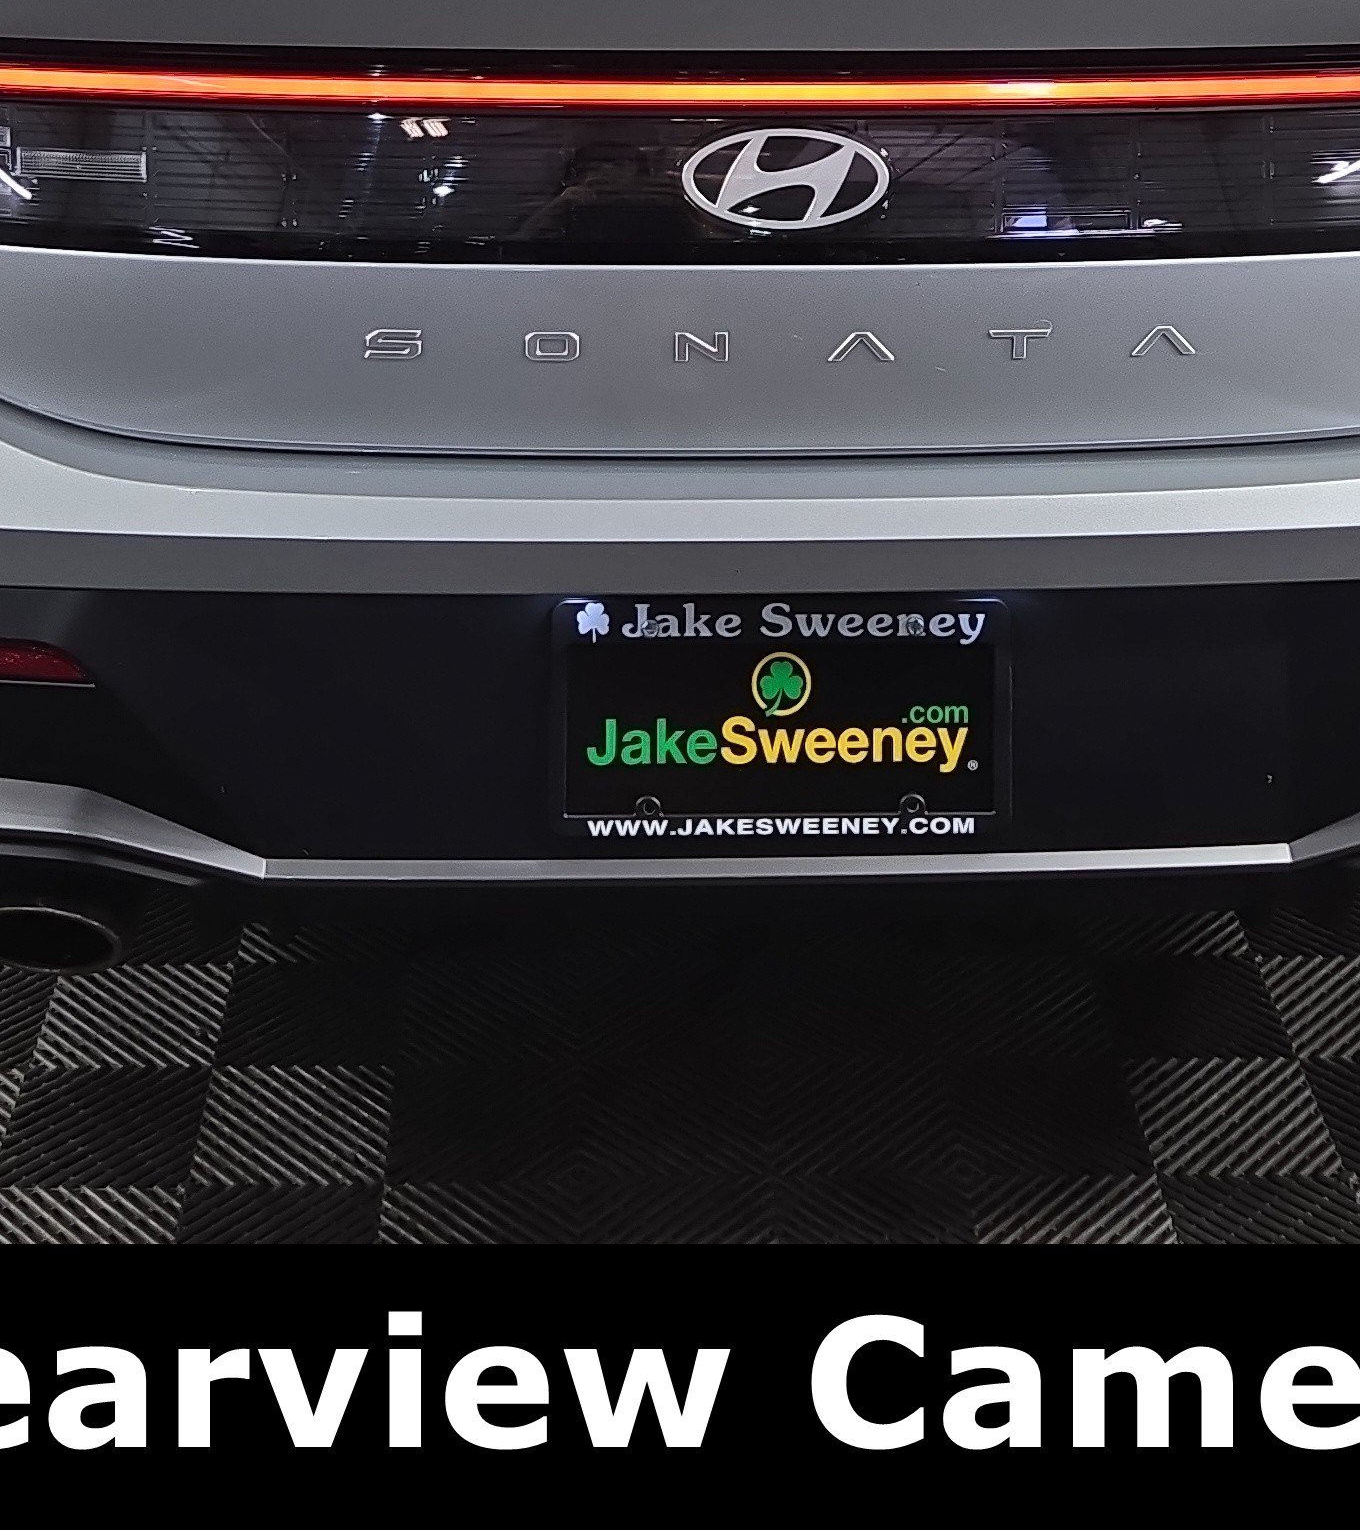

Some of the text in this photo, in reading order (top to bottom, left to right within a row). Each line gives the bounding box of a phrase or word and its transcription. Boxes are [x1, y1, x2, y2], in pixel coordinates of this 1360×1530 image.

[363, 324, 1197, 363] SONATA
[621, 602, 986, 645] Jake Sweeney
[901, 704, 969, 724] .com
[587, 817, 975, 837] WWW.JAKESWEENEY.COM
